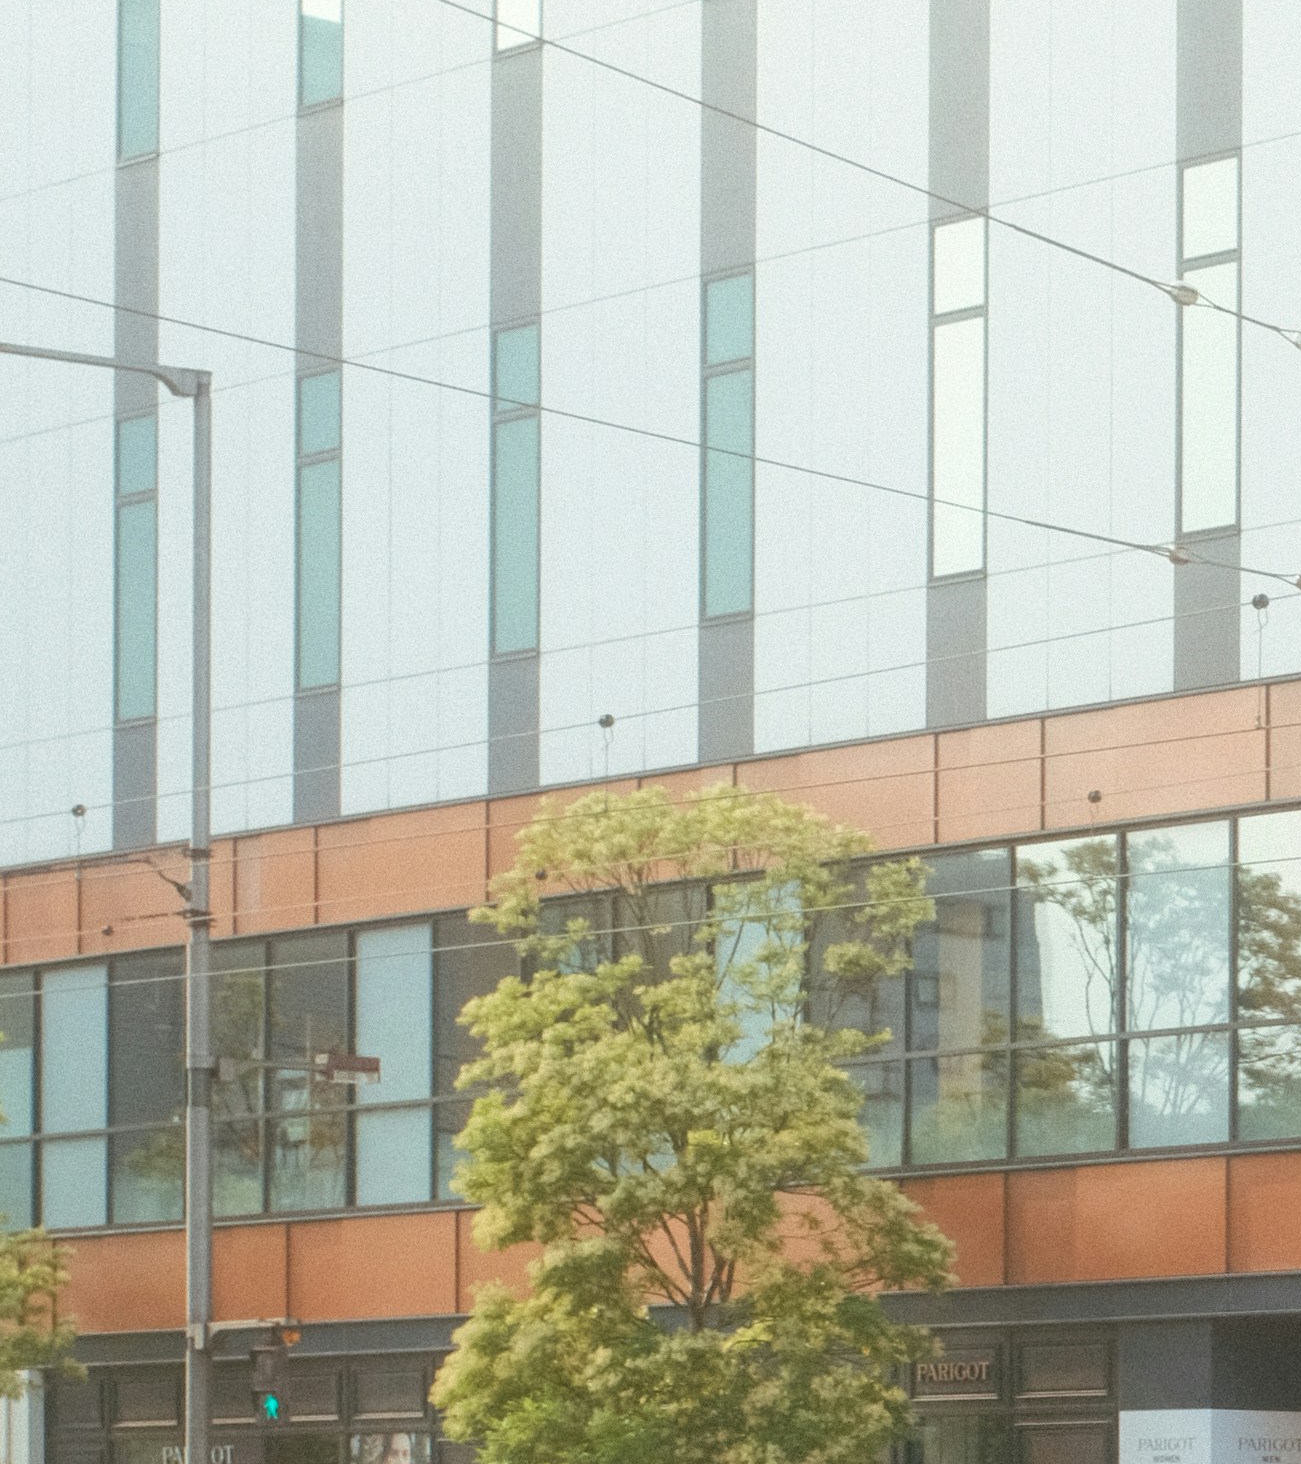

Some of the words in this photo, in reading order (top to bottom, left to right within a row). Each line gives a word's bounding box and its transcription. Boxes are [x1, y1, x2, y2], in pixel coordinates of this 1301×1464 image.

[916, 1362, 990, 1382] PARIGOT
[1138, 1437, 1195, 1451] PARIGOT
[1262, 1455, 1281, 1463] MEN
